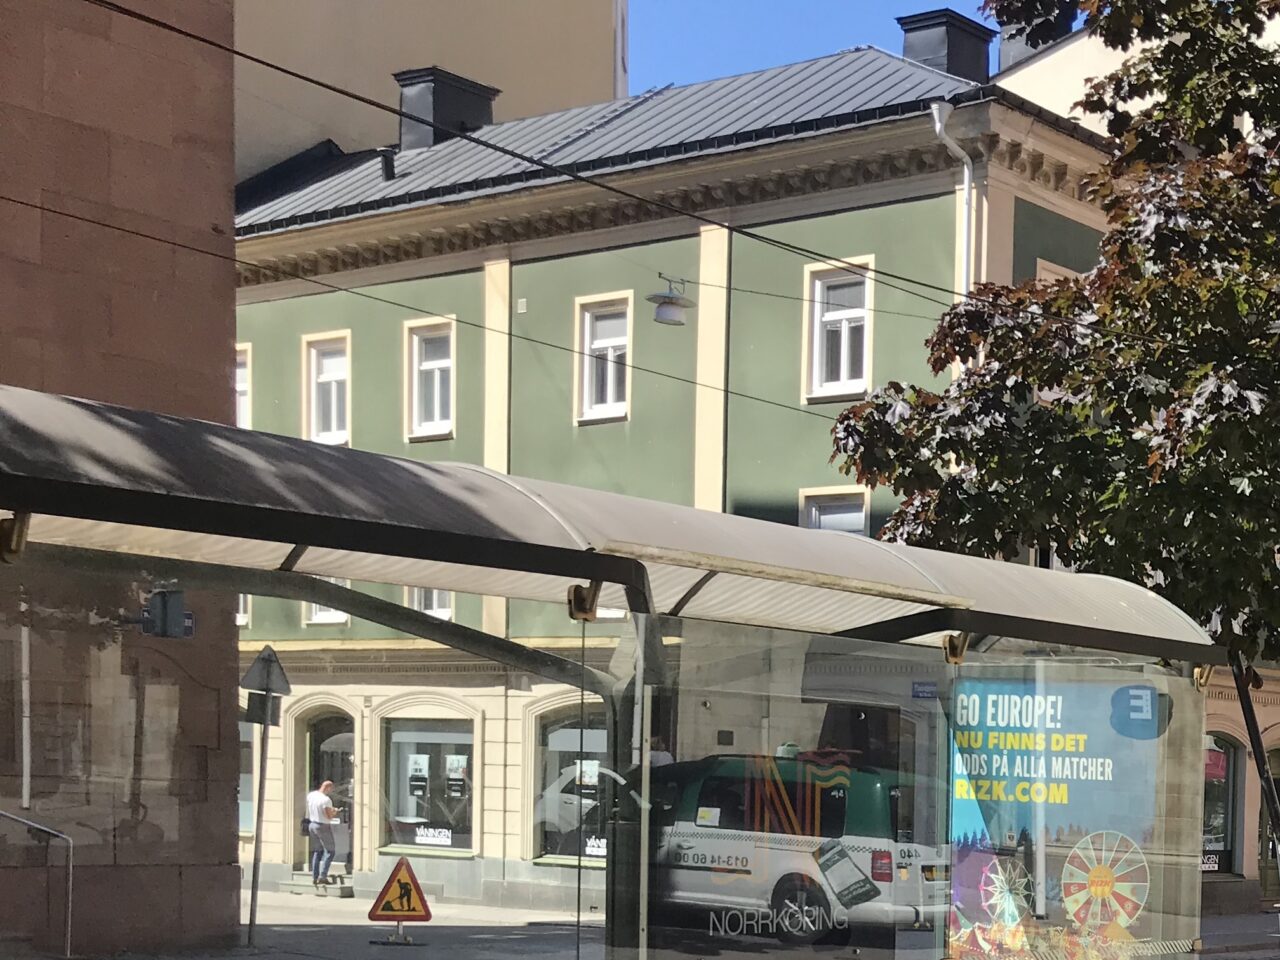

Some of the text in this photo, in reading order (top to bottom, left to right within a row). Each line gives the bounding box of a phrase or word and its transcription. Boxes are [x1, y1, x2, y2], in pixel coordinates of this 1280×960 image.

[956, 693, 1063, 729] GO EUROPE!
[955, 730, 1088, 752] NU FINNS DET
[955, 750, 1113, 781] ODDS PÅ ALLA MATCHER
[955, 779, 1069, 805] RIZK.COM
[415, 825, 452, 839] VÅNINGEN
